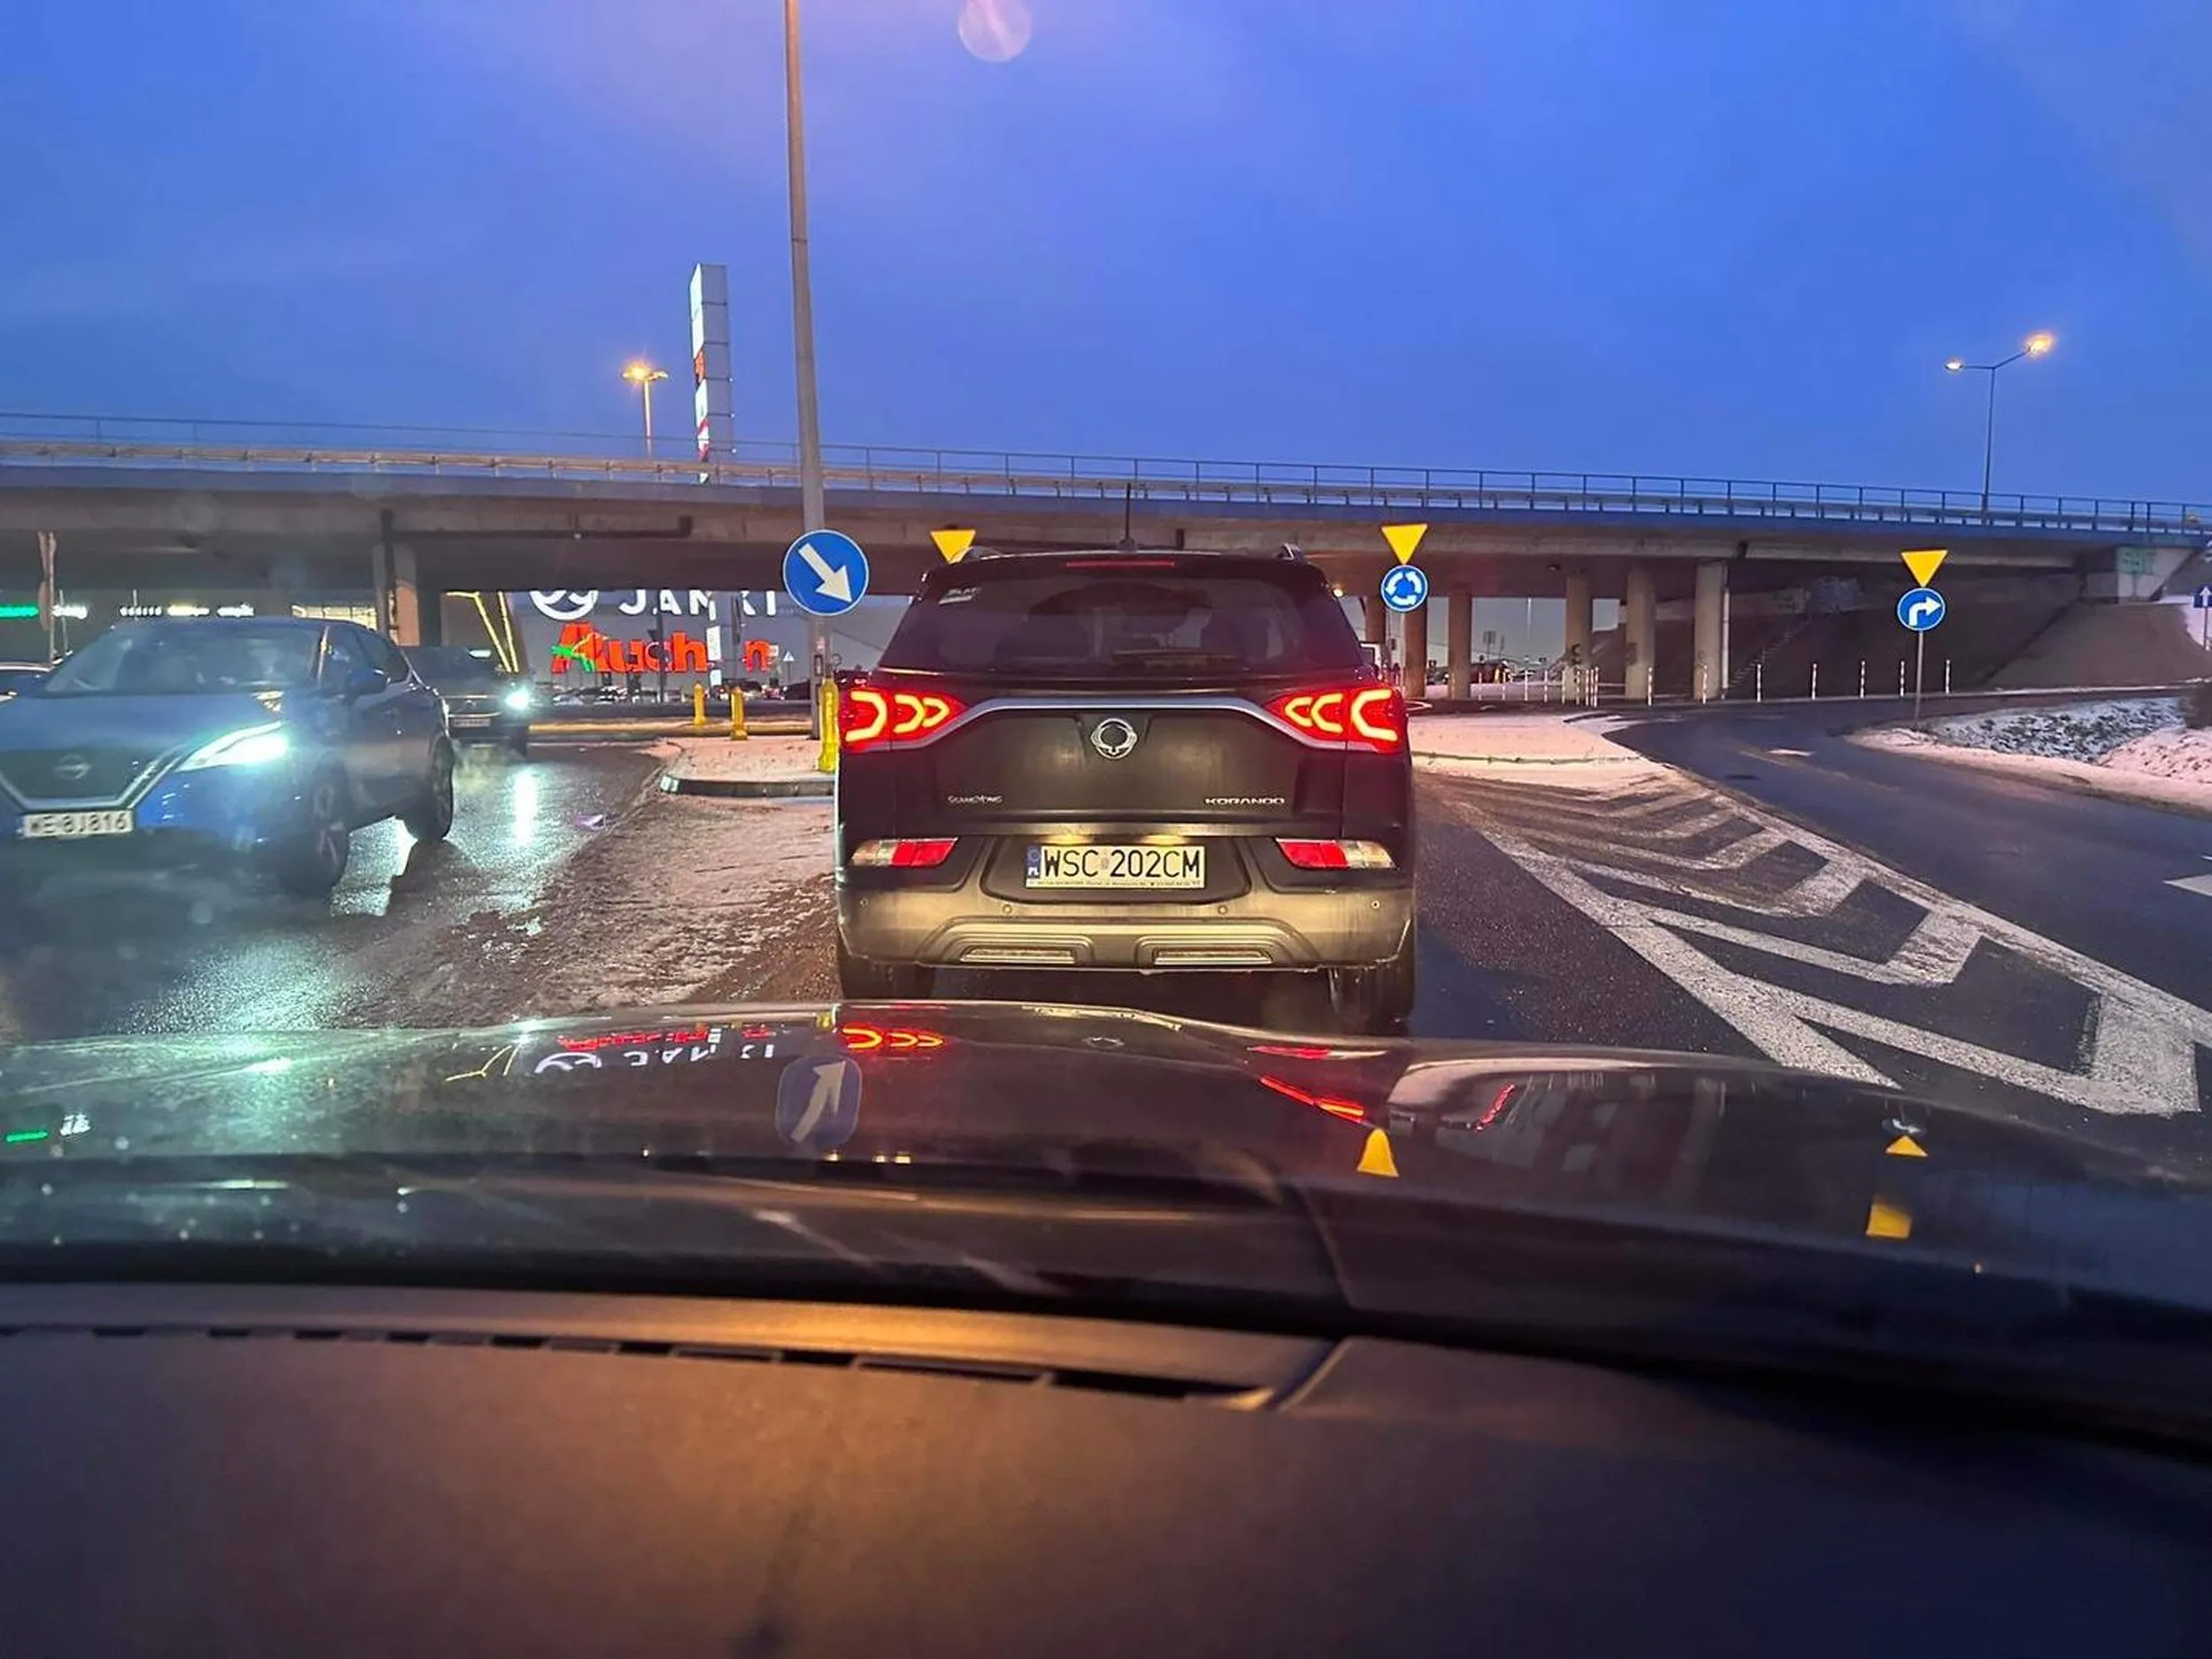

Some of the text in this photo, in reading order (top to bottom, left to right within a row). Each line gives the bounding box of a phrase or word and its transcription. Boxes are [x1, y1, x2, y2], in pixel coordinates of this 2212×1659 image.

[550, 621, 772, 673] Auchn
[1044, 849, 1200, 878] WSC 202CM
